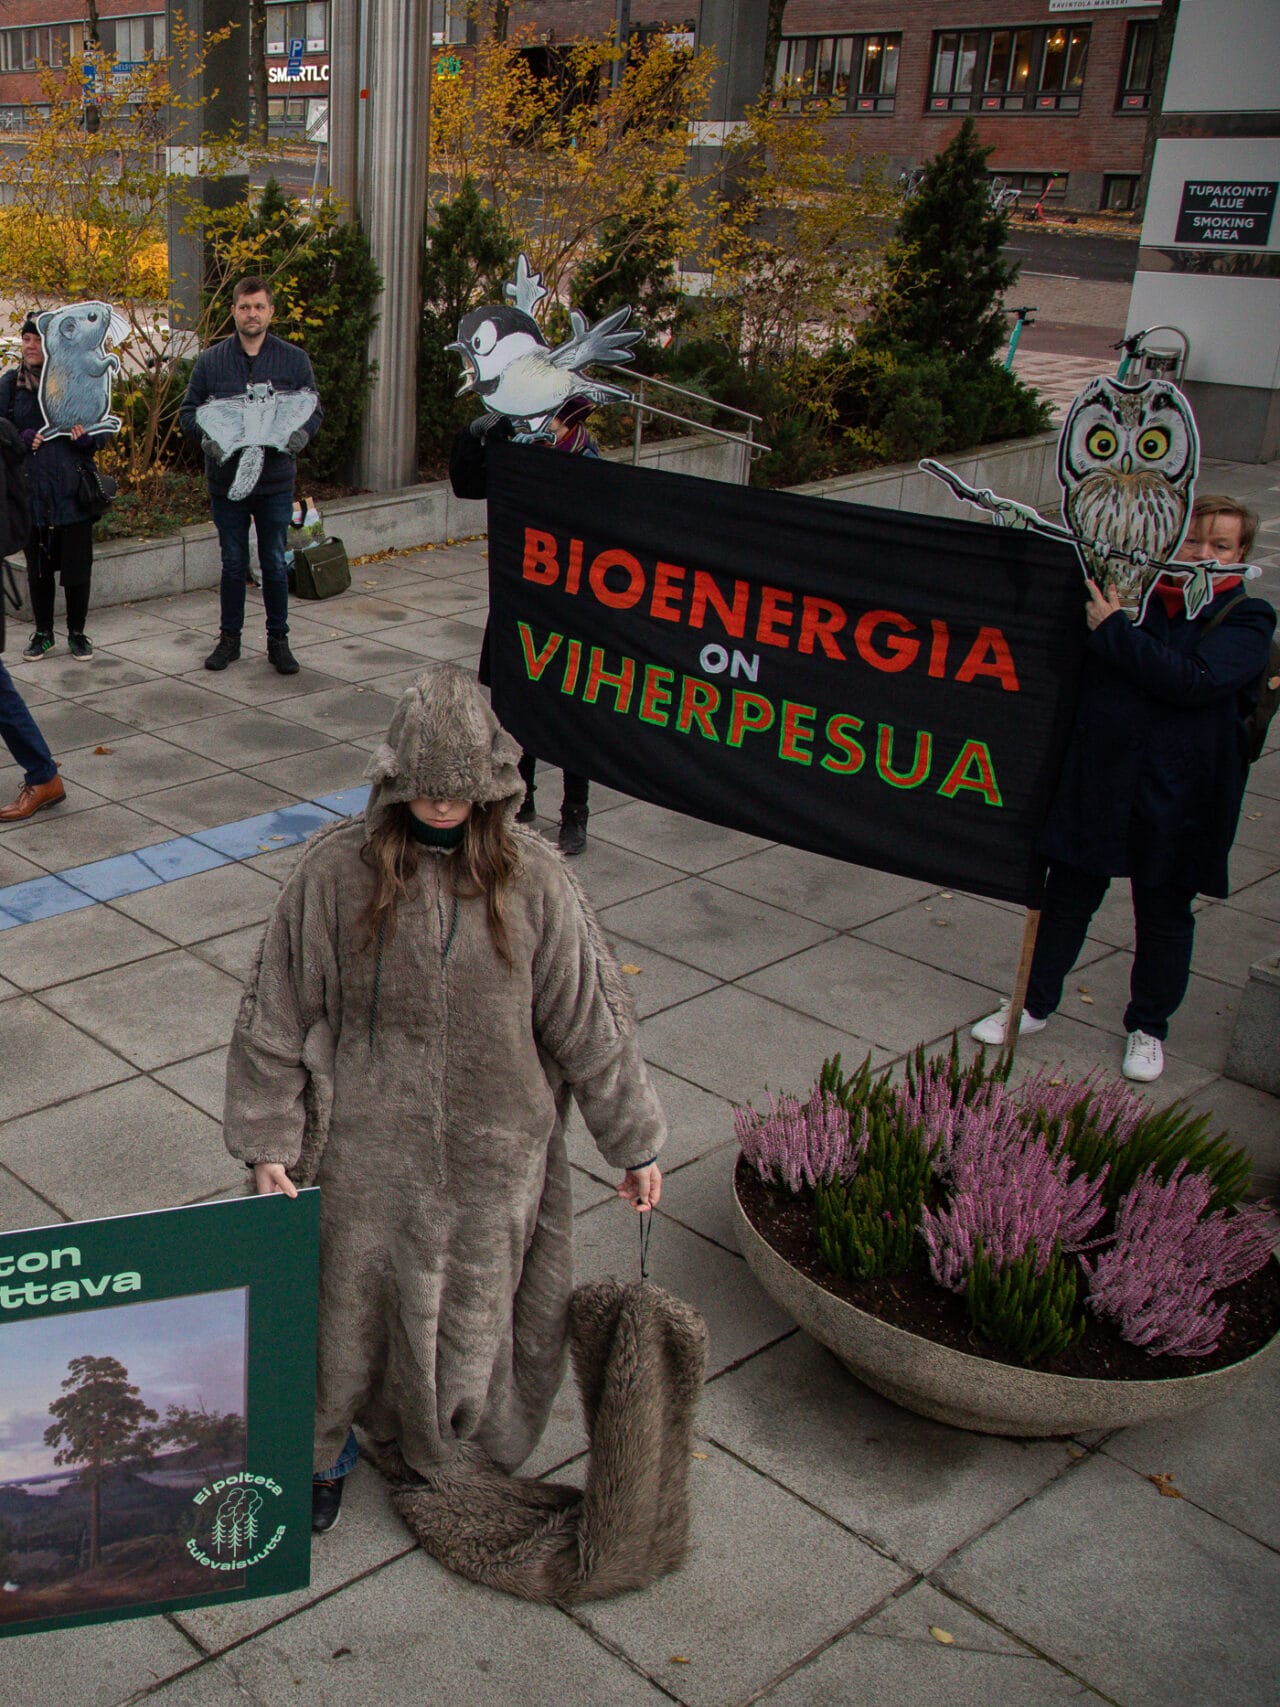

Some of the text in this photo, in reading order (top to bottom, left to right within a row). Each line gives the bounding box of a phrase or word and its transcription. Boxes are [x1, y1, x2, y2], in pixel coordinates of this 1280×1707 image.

[1188, 185, 1273, 197] TUPAKOINTI-
[1209, 198, 1245, 209] ALUE
[1192, 217, 1254, 228] SMOKING
[1201, 229, 1239, 240] AREA
[521, 526, 1020, 692] BIOENERGIA
[699, 642, 761, 682] ON
[517, 620, 1003, 807] VIHERPESUA
[192, 1472, 283, 1506] Ei polteta
[186, 1525, 286, 1571] tulevaisuutta
